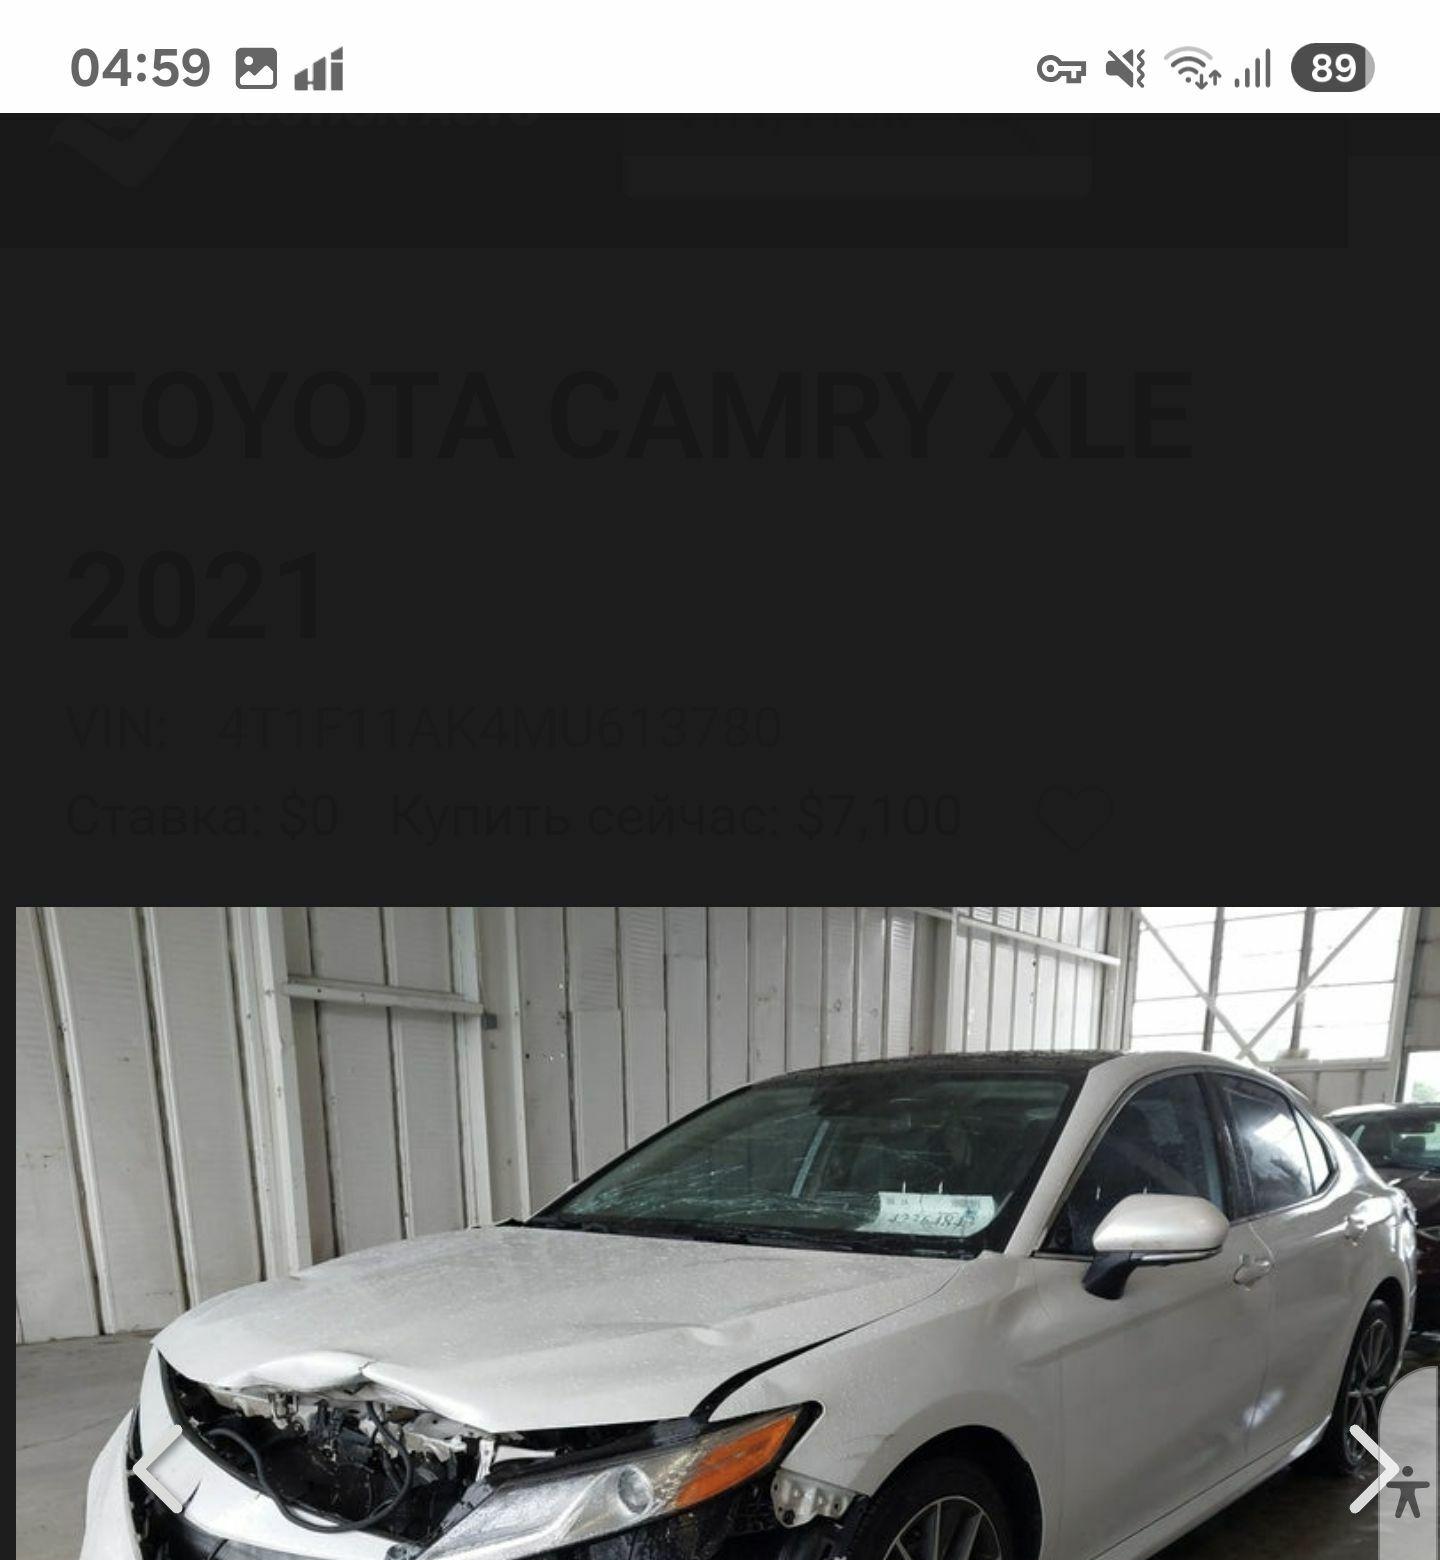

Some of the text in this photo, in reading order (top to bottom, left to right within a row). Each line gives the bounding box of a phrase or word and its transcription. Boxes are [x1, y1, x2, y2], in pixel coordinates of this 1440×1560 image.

[71, 48, 210, 88] 04:59
[1311, 54, 1357, 82] 89
[66, 371, 1193, 461] TOYOTA CAMRY XLE
[67, 550, 321, 640] 2021
[64, 704, 784, 750] VIN: 4T1F11AK4MU613780
[66, 787, 960, 846] Ставка: $0 Купить сейчас: $7,100
